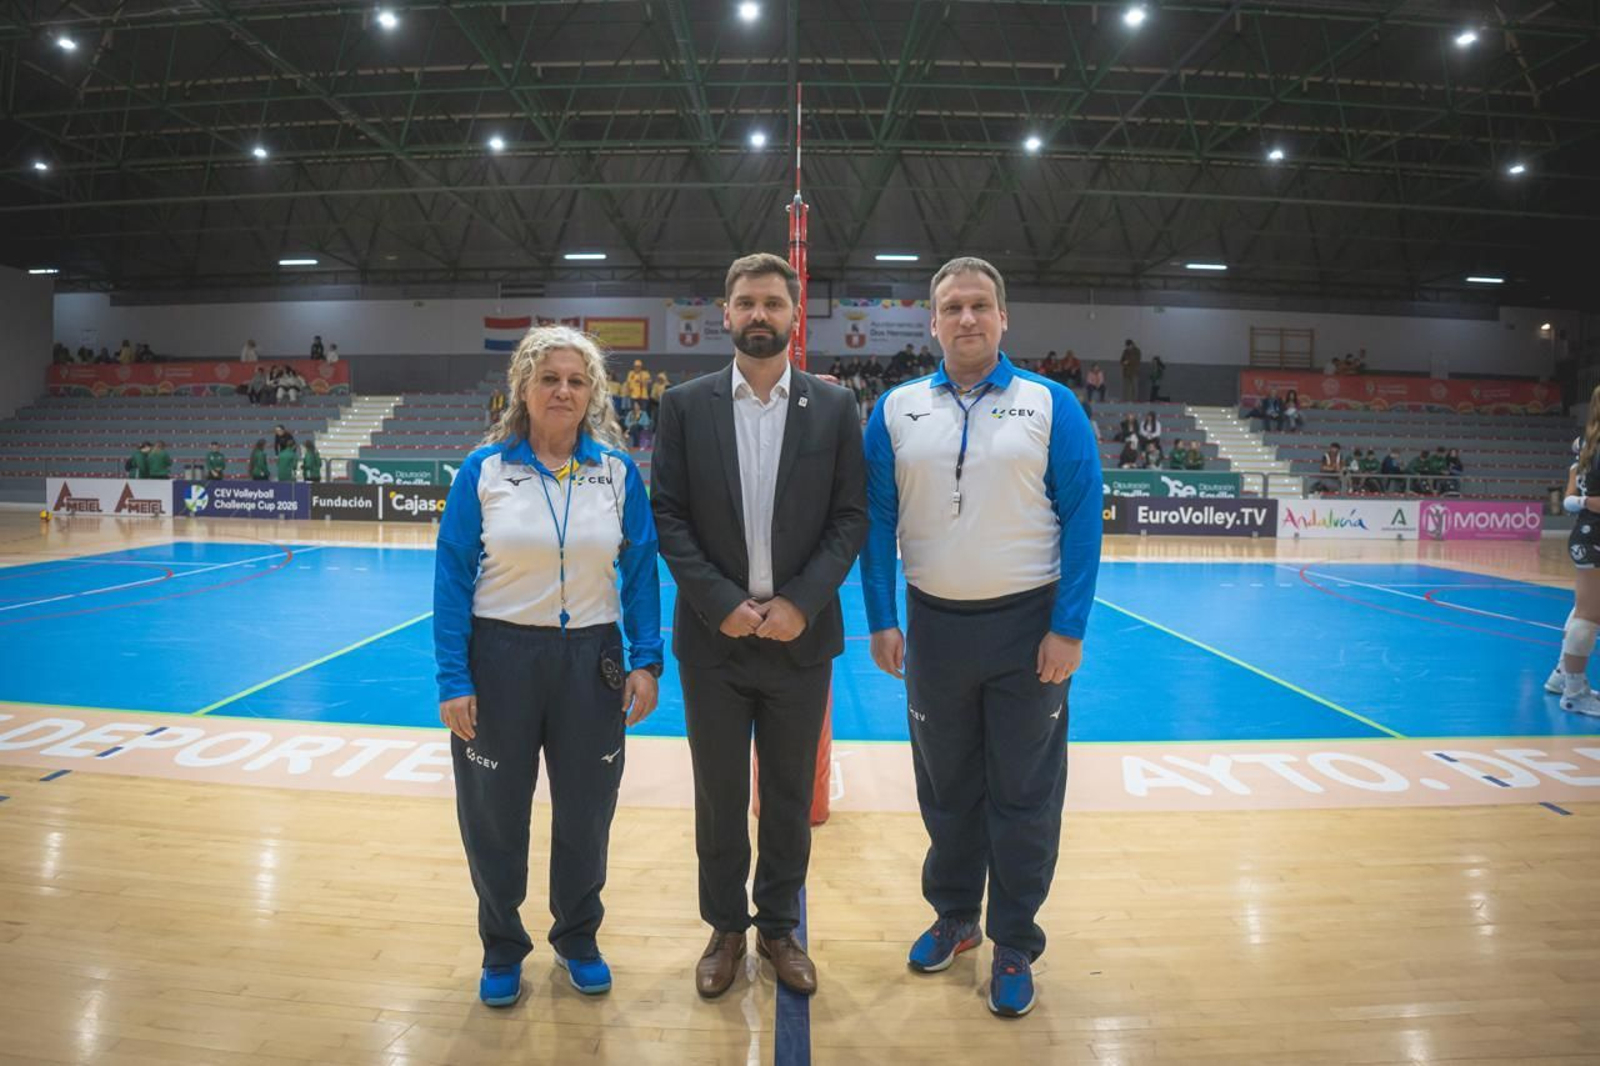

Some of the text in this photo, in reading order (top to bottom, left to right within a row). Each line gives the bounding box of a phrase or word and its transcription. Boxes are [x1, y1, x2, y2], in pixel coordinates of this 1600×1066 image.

[1008, 408, 1035, 417] CEV
[588, 476, 613, 485] CEV
[214, 488, 275, 500] CEV Volleyball
[214, 499, 298, 512] Challenge Cup 2026
[312, 495, 372, 508] Fundación
[1137, 506, 1267, 529] EuroVolley.TV
[0, 717, 452, 782] DEPORTE
[476, 756, 499, 770] CEV
